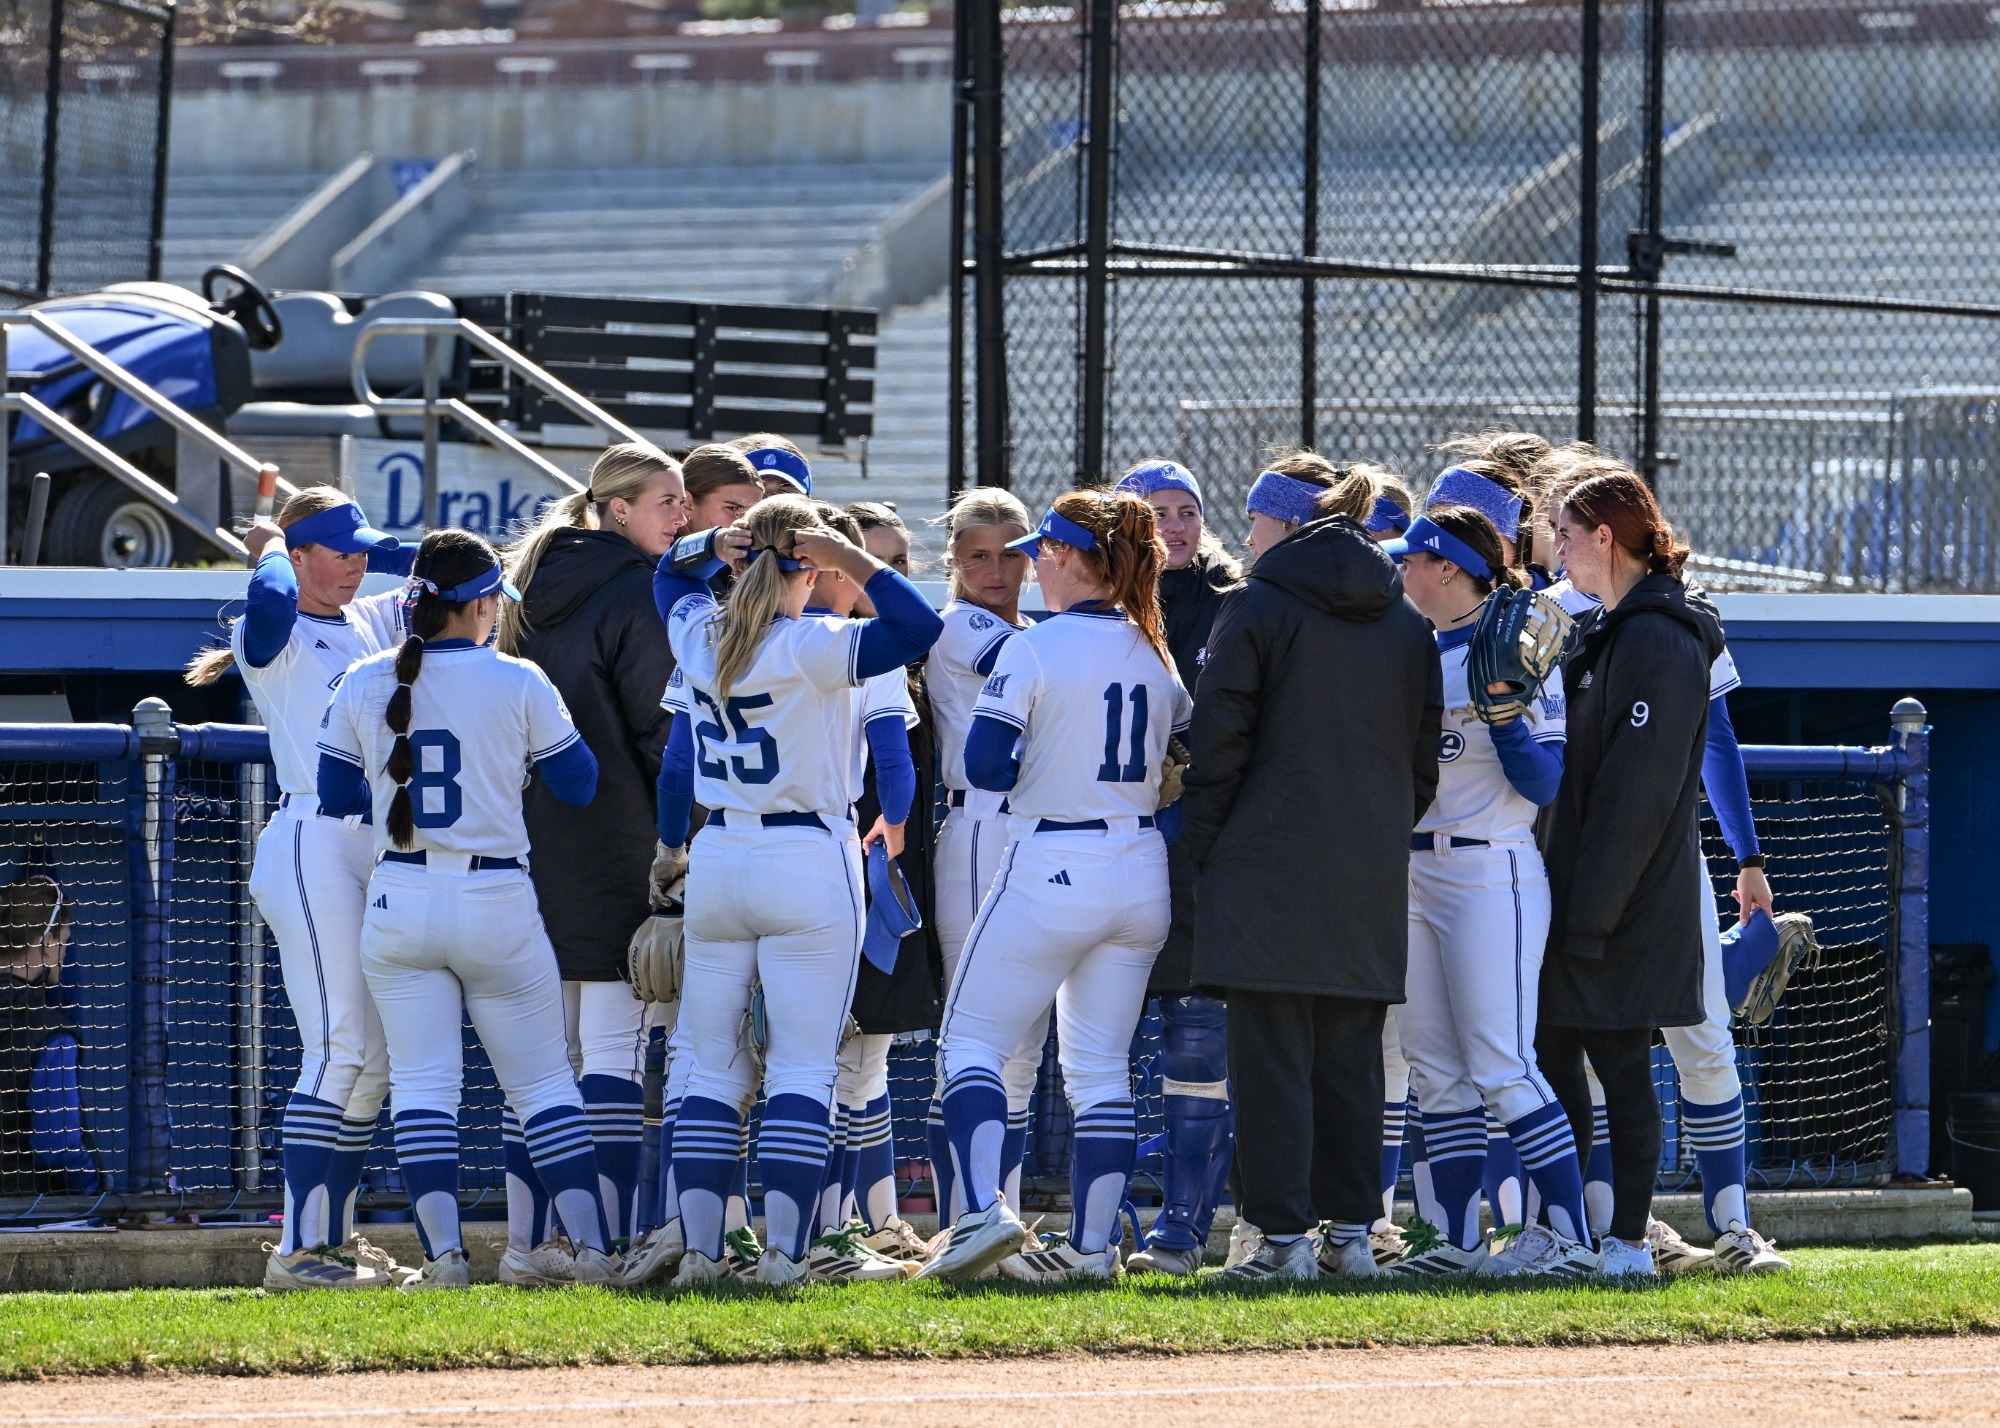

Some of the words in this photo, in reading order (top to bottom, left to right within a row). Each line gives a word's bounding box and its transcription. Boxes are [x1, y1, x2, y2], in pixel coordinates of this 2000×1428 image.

[1505, 603, 1520, 643] EASTON
[692, 685, 780, 785] 25
[1096, 682, 1149, 782] 11
[1630, 701, 1650, 728] 9
[405, 728, 463, 829] 8
[632, 946, 643, 991] EASTON
